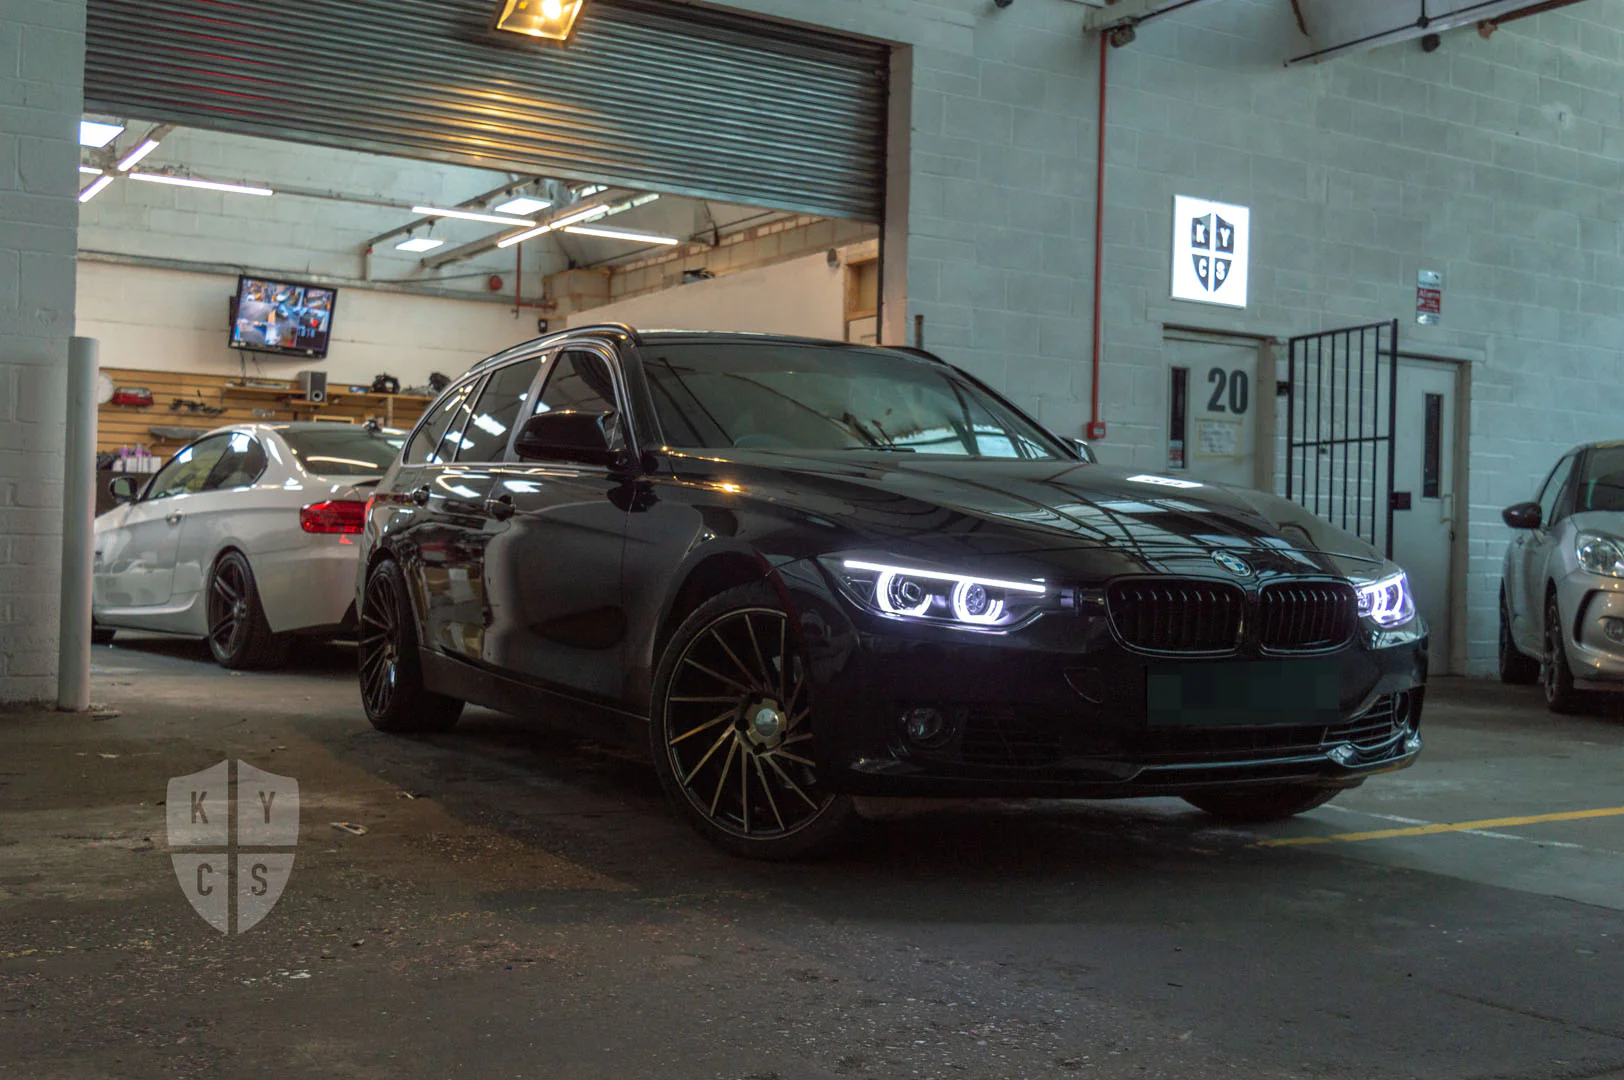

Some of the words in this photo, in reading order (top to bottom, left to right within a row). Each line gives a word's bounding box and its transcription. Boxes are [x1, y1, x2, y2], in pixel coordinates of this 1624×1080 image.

[1195, 223, 1206, 244] K
[1219, 226, 1231, 248] Y
[1215, 261, 1226, 281] S
[1207, 367, 1249, 415] 20
